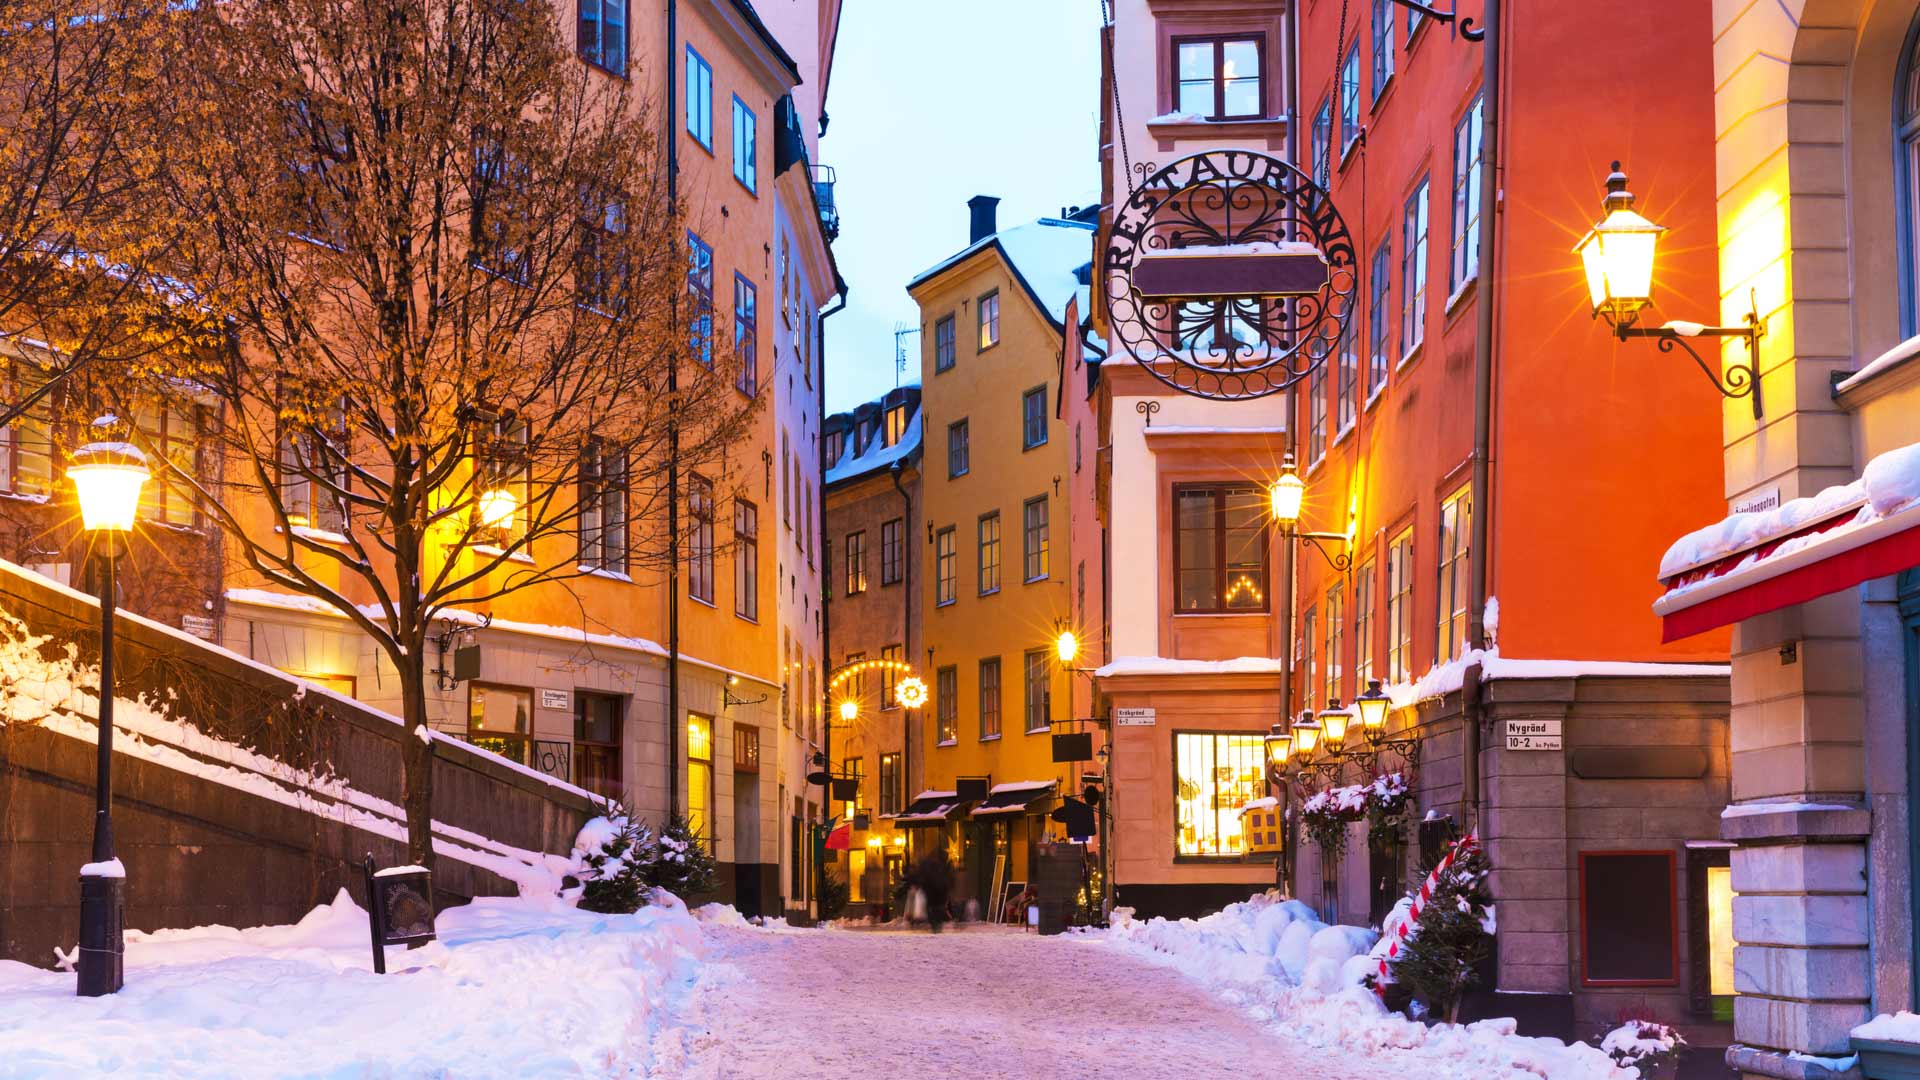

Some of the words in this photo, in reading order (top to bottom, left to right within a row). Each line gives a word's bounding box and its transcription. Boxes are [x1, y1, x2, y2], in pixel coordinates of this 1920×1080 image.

[1105, 152, 1352, 274] RESTAURANG
[1509, 723, 1546, 734] Nygränd
[1510, 737, 1530, 748] 10-2
